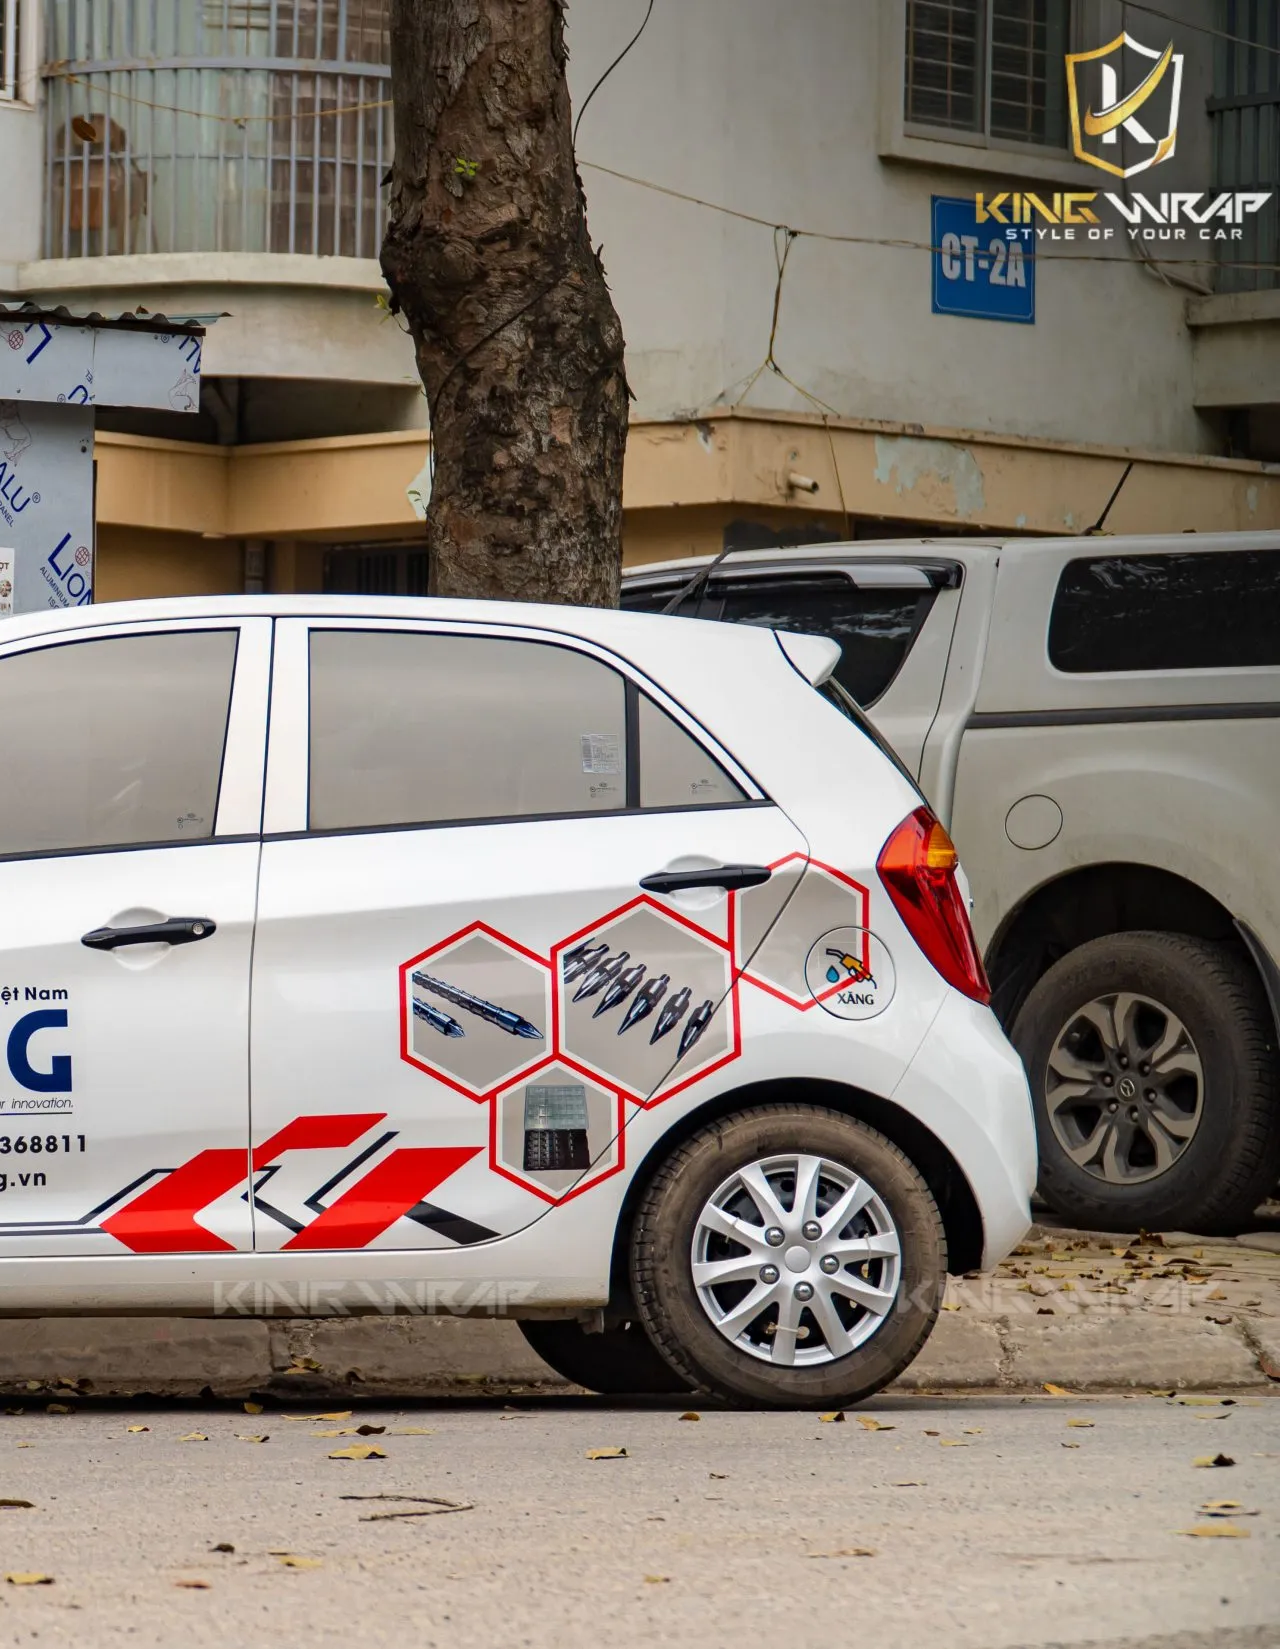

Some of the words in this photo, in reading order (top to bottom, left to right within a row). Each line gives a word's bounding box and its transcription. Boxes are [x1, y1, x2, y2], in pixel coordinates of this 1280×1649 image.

[941, 232, 1027, 288] CT-2A
[23, 987, 69, 1001] Nam
[836, 990, 875, 1006] XĂNG
[11, 1097, 74, 1109] innovation.
